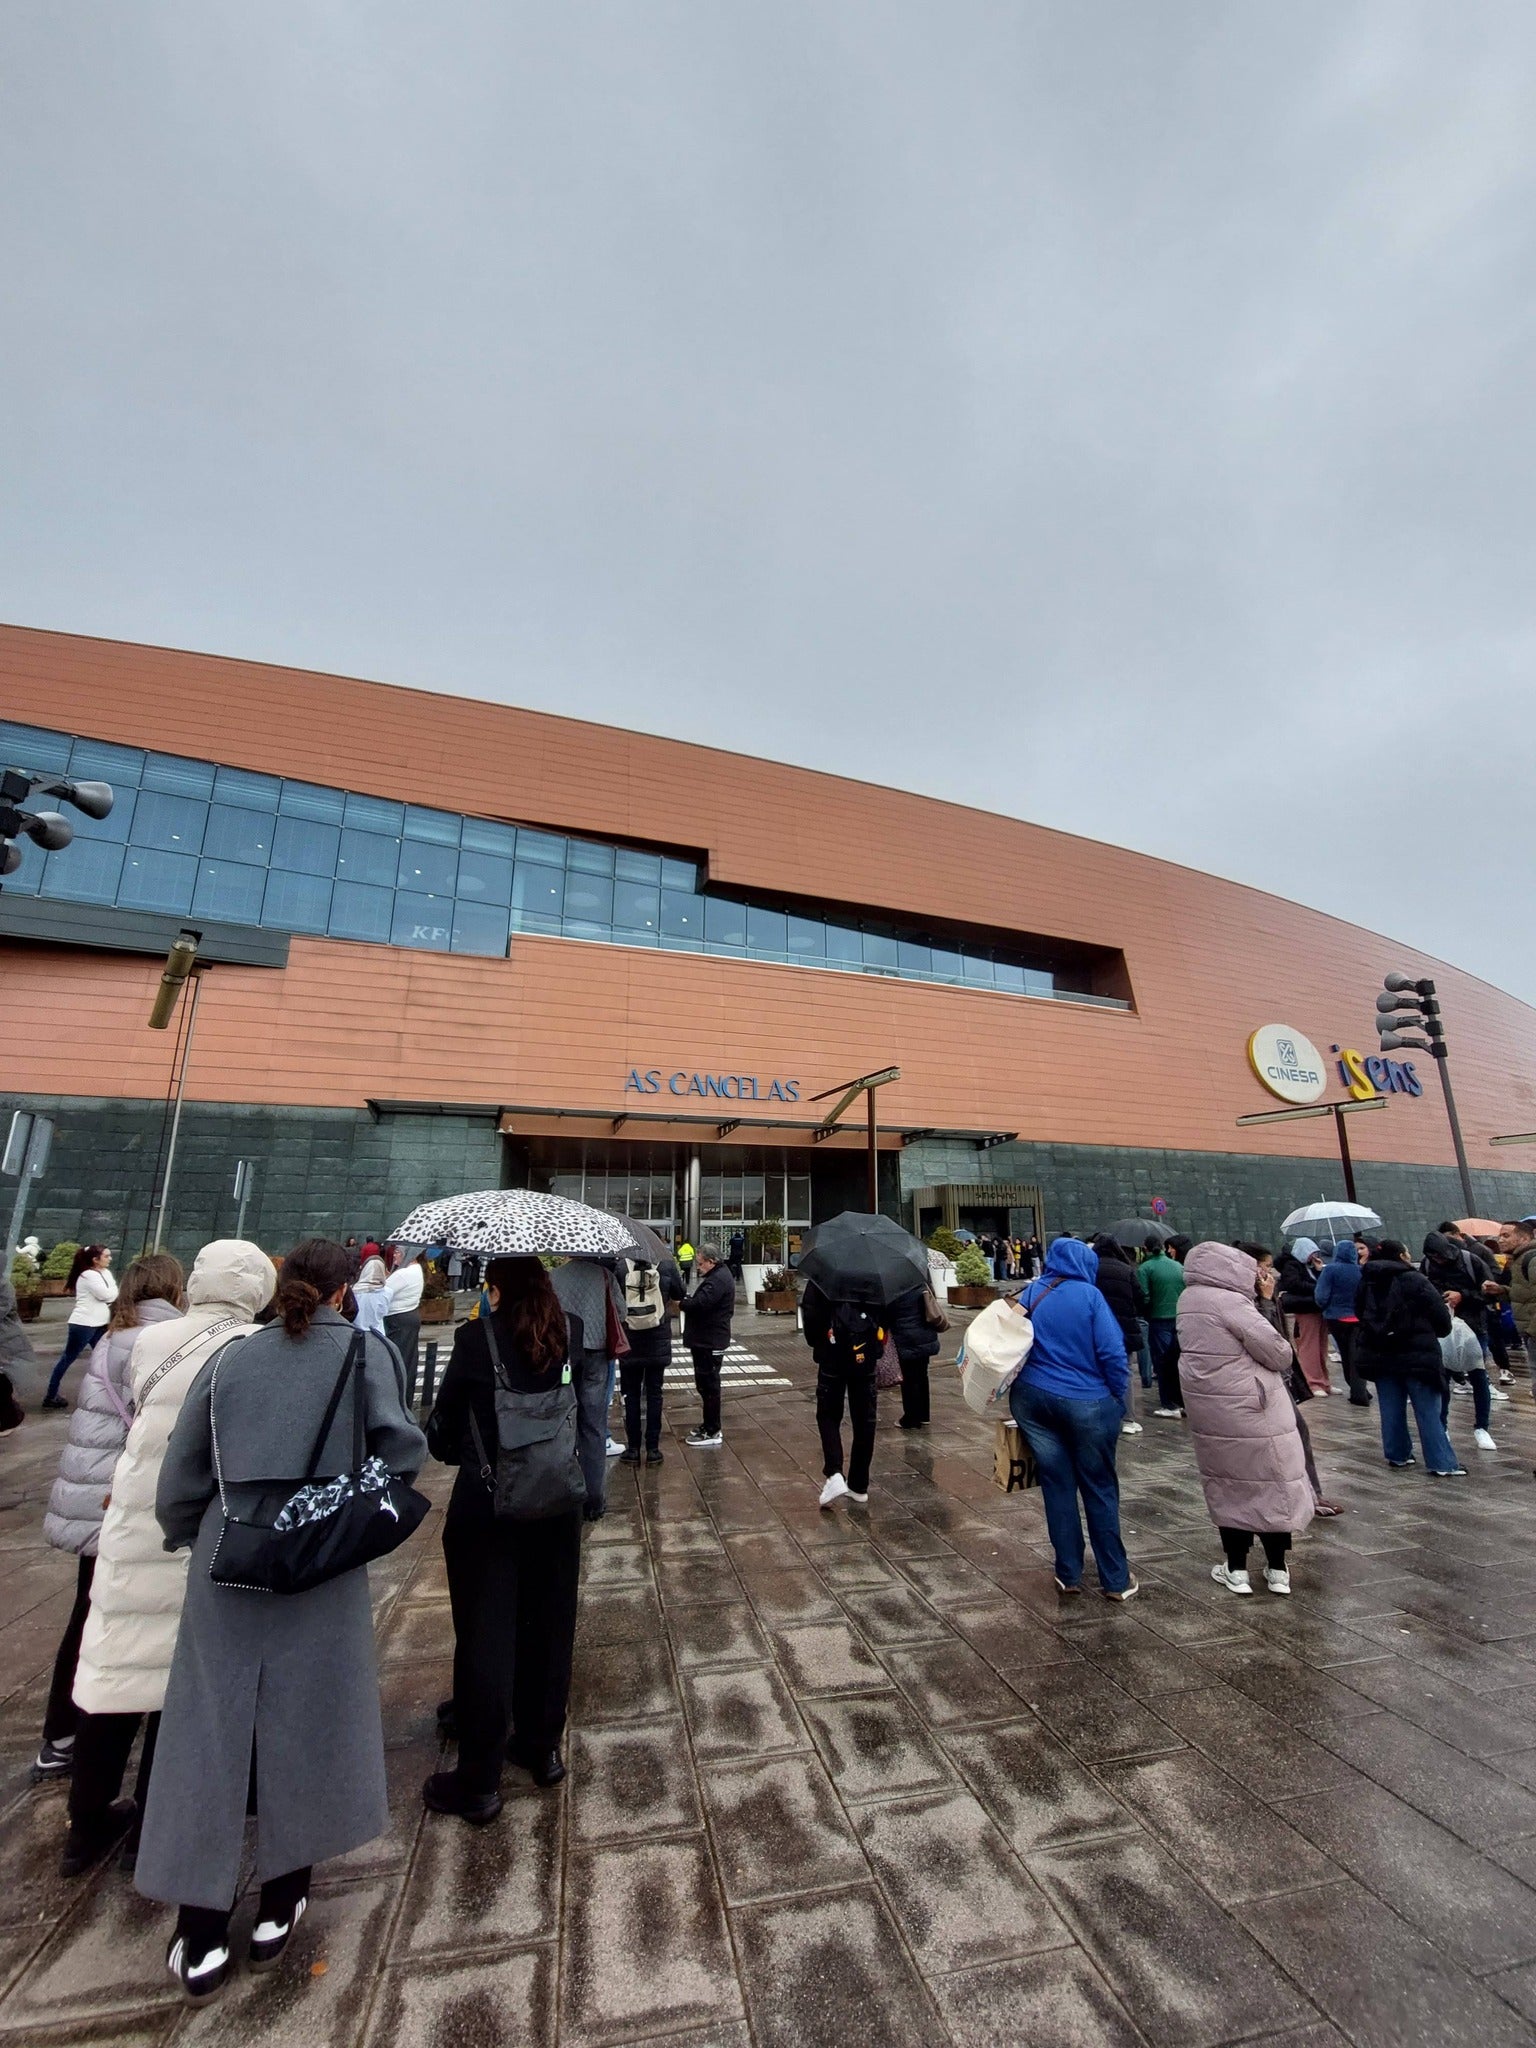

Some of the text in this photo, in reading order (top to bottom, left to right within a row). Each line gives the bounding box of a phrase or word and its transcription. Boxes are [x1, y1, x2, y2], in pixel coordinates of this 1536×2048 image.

[412, 925, 462, 943] KFC
[1267, 1066, 1319, 1084] CINESA
[1330, 1044, 1423, 1100] iSens
[624, 1069, 800, 1102] AS CANCELAS
[160, 1352, 183, 1373] KORS
